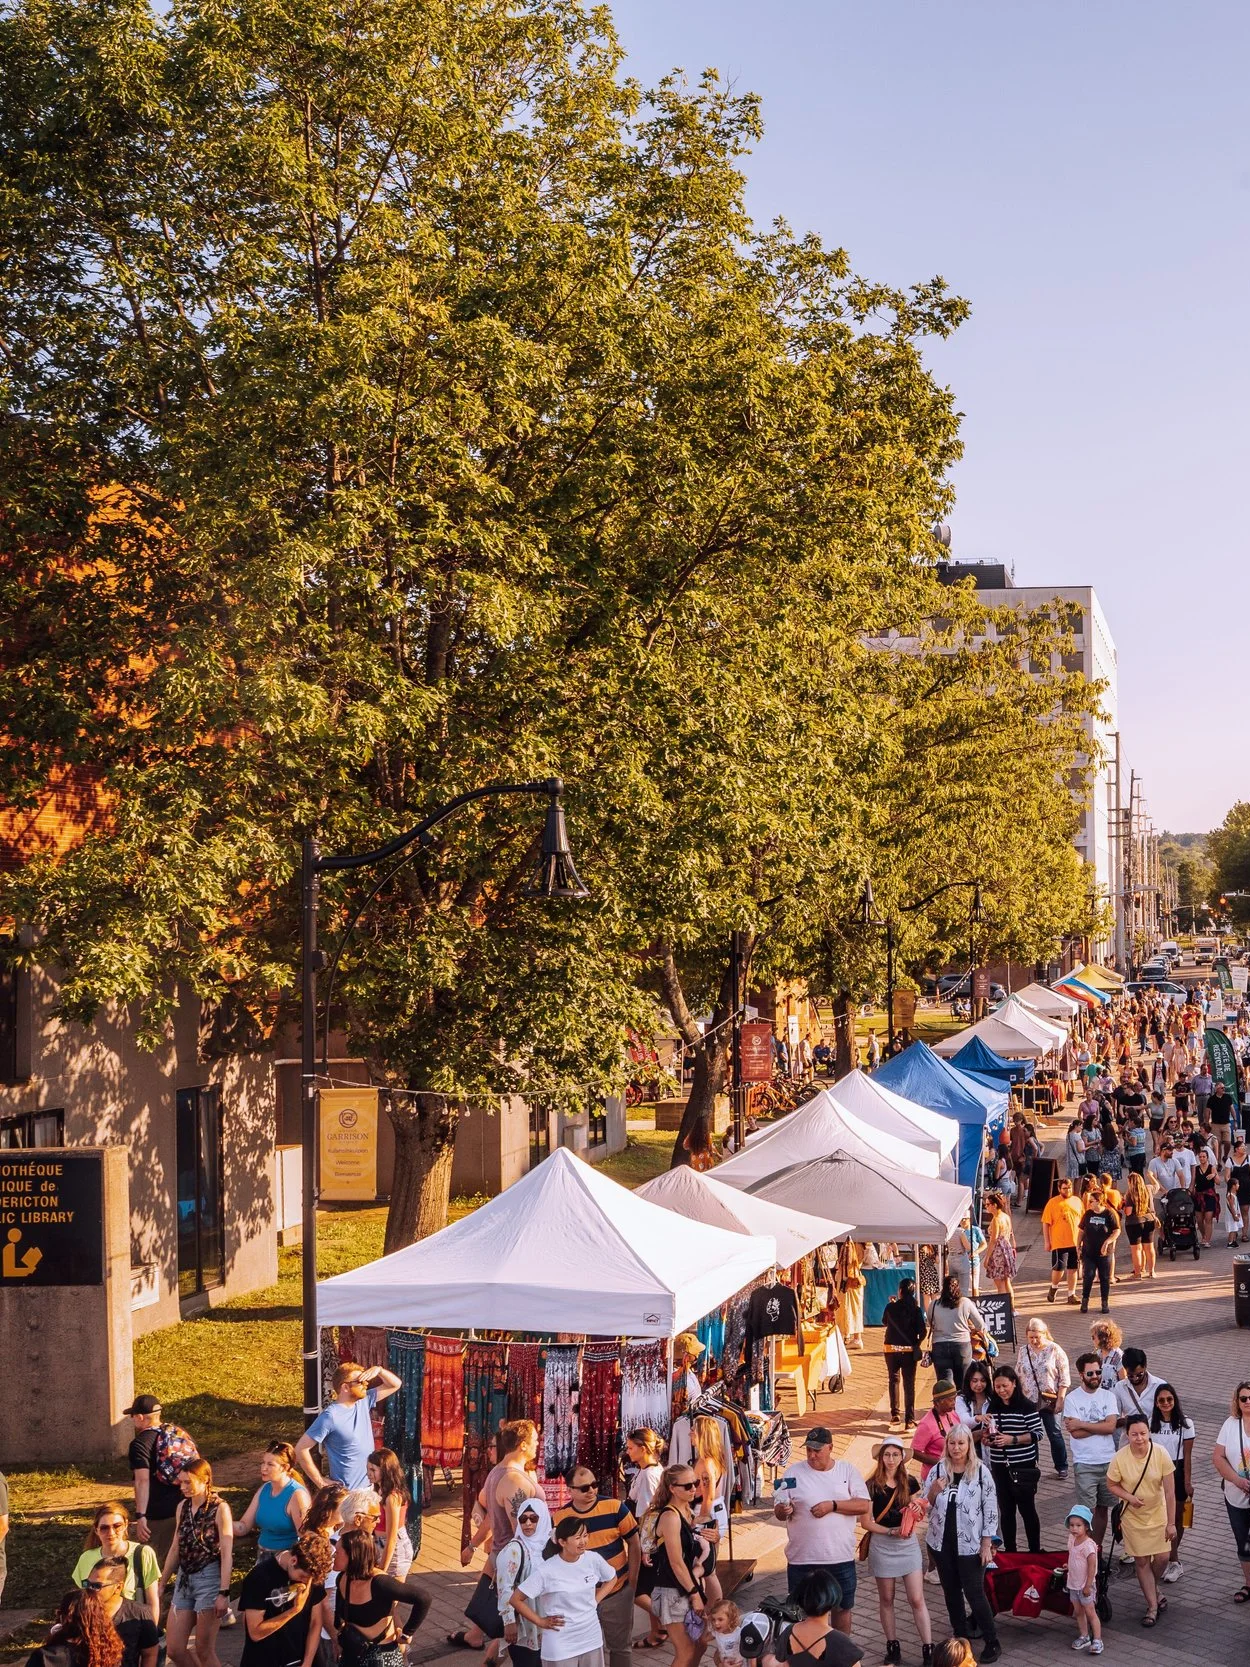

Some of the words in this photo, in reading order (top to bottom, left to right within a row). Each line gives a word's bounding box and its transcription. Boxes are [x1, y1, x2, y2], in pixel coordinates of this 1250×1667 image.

[1221, 1043, 1230, 1065] POSTE
[1212, 1044, 1224, 1080] RECYCLAGE
[1223, 1063, 1231, 1072] DE
[327, 1132, 369, 1141] GARRISON
[0, 1161, 63, 1177] OTHÉQUE
[0, 1180, 32, 1193] IQUE
[41, 1180, 56, 1192] de
[0, 1196, 58, 1208] ERICTON
[0, 1212, 16, 1224] IC
[21, 1211, 74, 1224] LIBRARY
[981, 1312, 1006, 1332] FF
